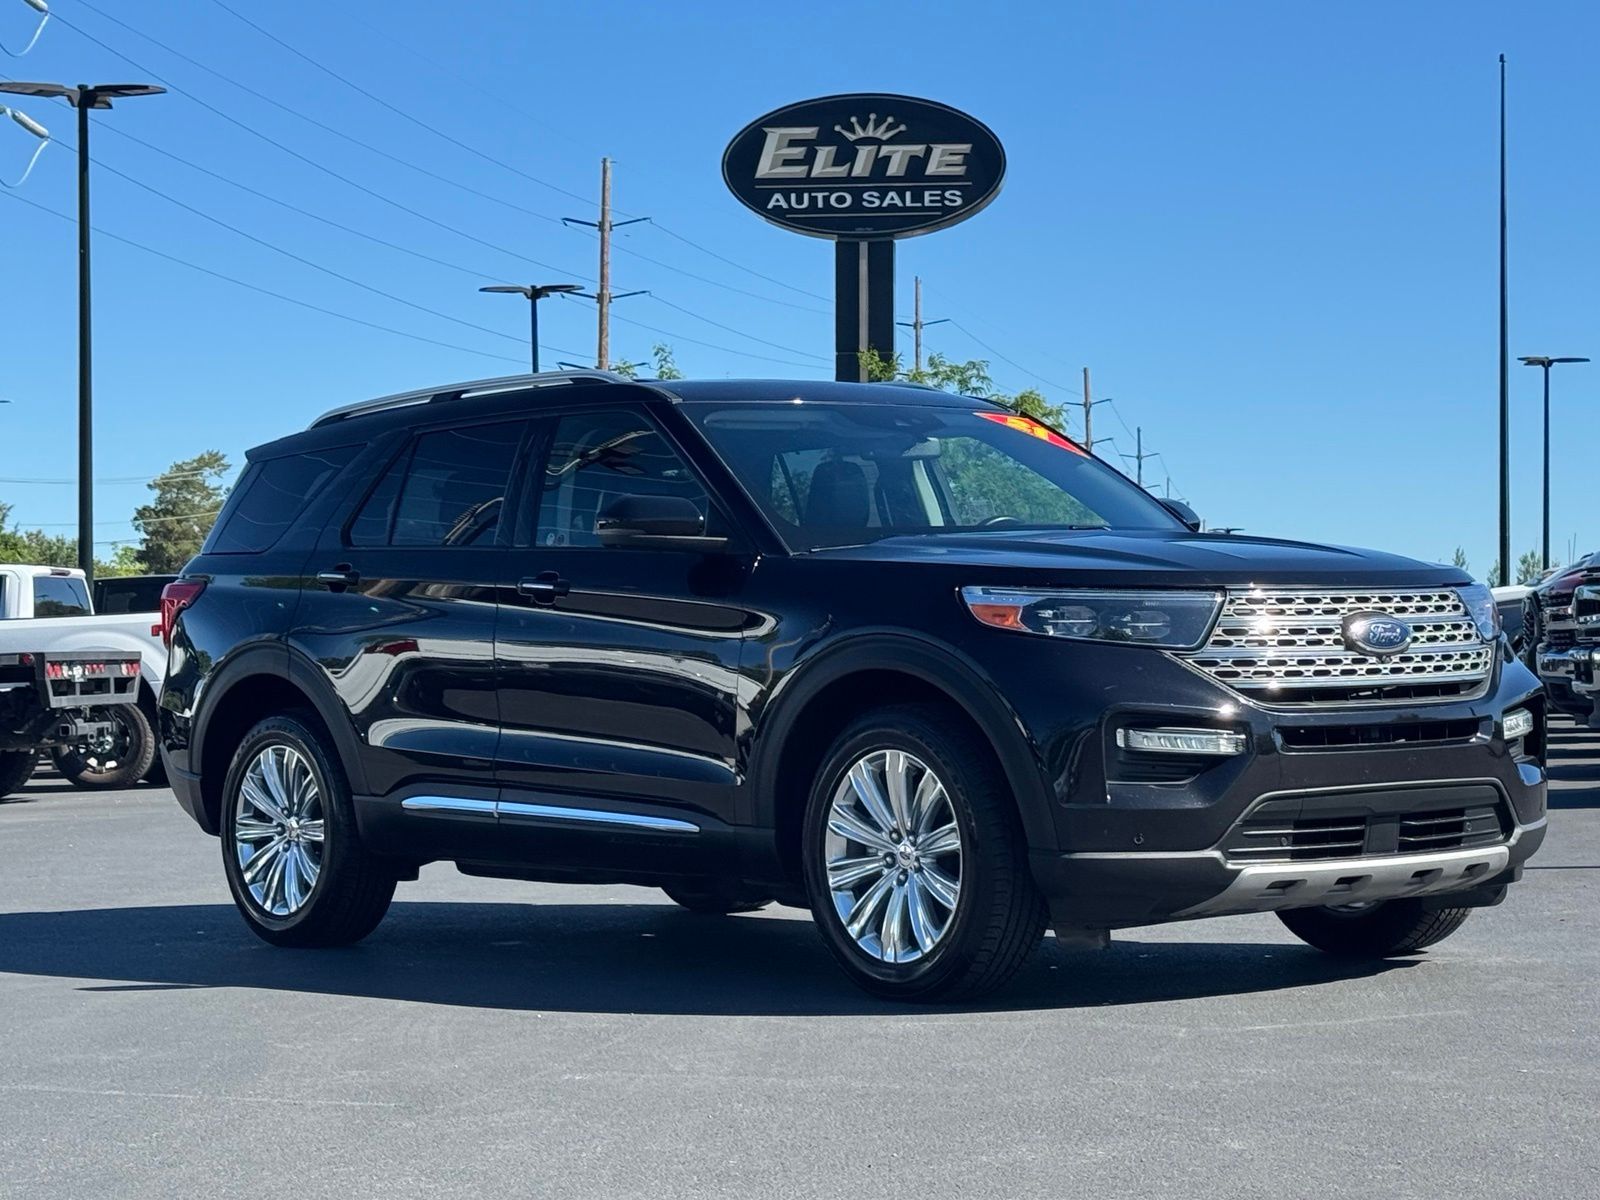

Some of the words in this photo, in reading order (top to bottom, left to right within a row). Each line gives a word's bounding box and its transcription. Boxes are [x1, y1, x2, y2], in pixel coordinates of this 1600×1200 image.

[754, 126, 973, 179] ELITE
[766, 192, 852, 209] AUTO
[862, 190, 963, 208] SALES
[1369, 623, 1401, 643] Ford
